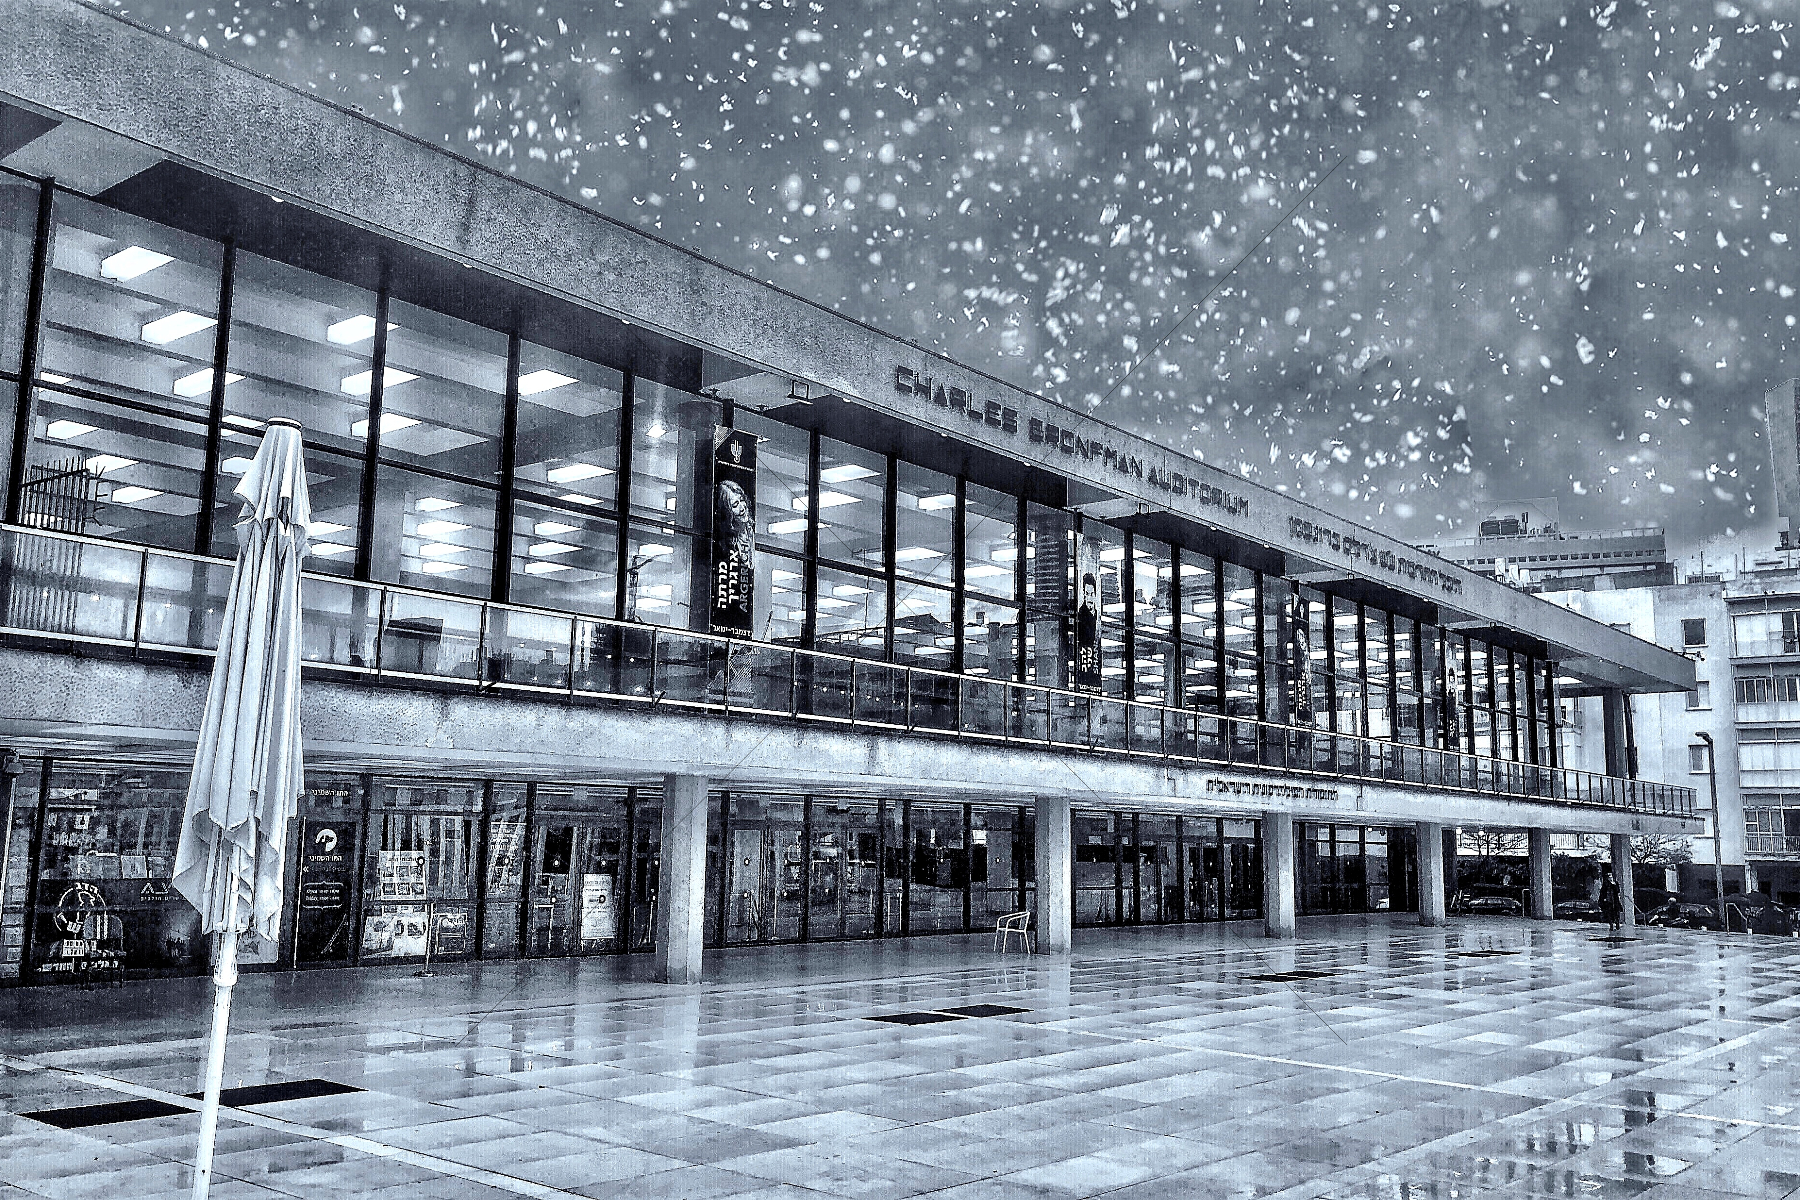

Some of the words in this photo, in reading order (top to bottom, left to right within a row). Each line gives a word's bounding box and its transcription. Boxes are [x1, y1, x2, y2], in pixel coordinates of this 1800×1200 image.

[896, 364, 1018, 434] CHARLES
[1029, 416, 1143, 478] BRONFMAN
[1147, 465, 1250, 518] AUDITORIUM
[717, 561, 727, 609] מרתה
[729, 549, 739, 605] ארגריך
[1206, 777, 1251, 795] הישראלית
[1252, 782, 1304, 799] הפילהרמונית
[1306, 787, 1339, 801] התזמורת
